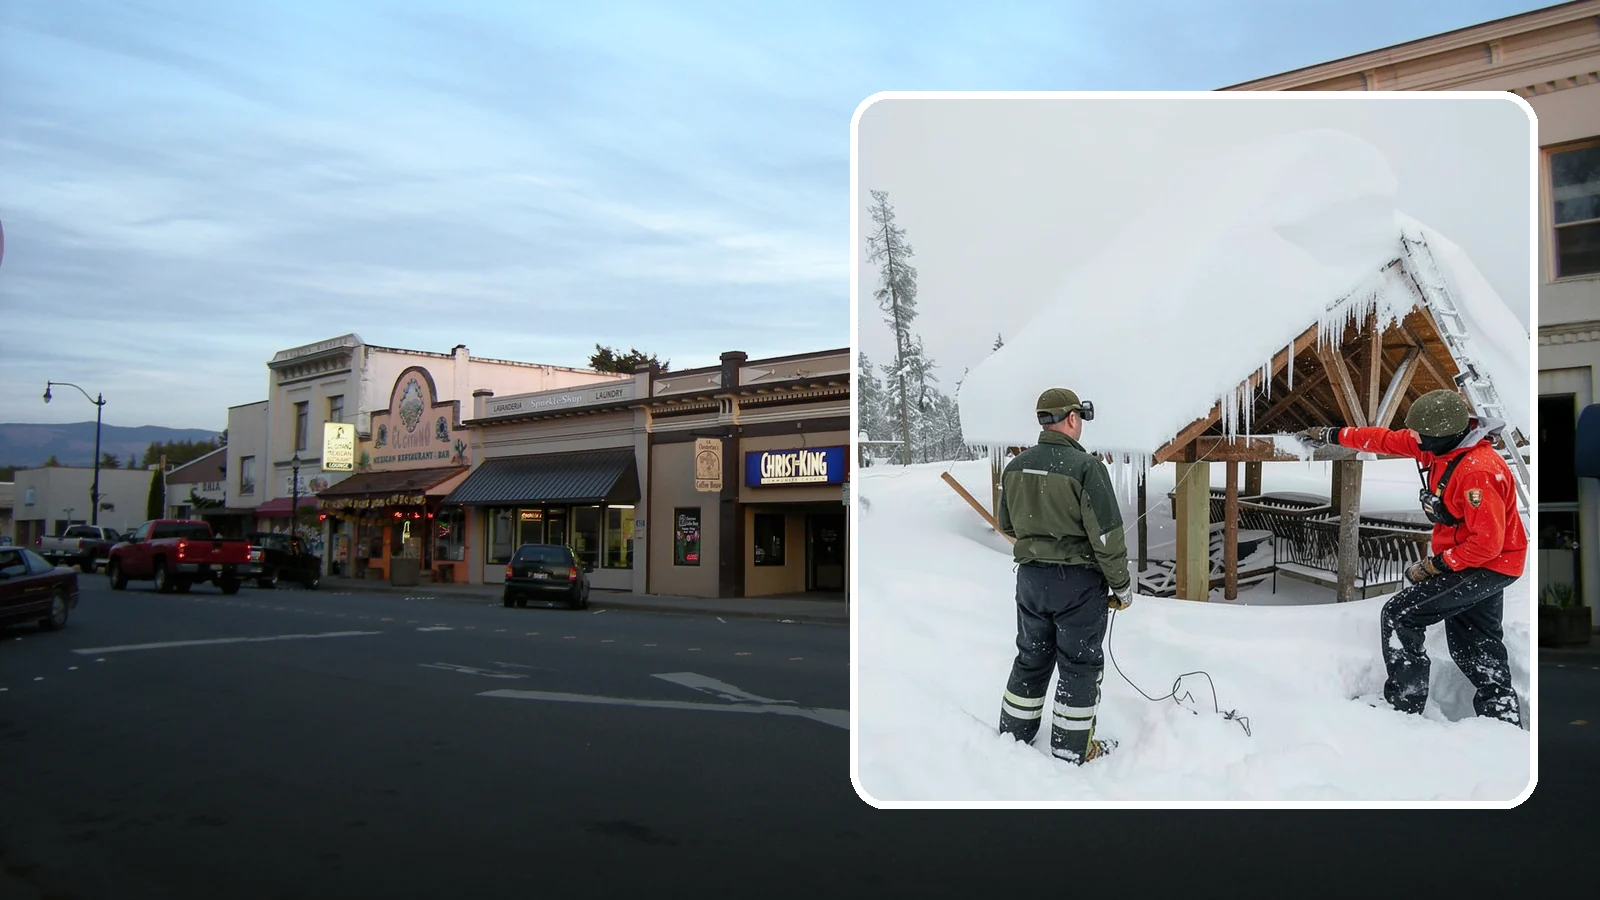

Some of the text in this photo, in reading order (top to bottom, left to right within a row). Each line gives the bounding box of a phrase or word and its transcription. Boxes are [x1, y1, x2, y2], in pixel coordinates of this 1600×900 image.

[493, 389, 624, 412] LAVANDERIA Sparkle Shop LAUNDRY
[392, 425, 403, 449] EL
[373, 454, 396, 464] MEXICAN
[397, 452, 433, 463] RESTAURANT
[437, 450, 450, 459] BAR
[761, 450, 827, 478] CHRIST KING
